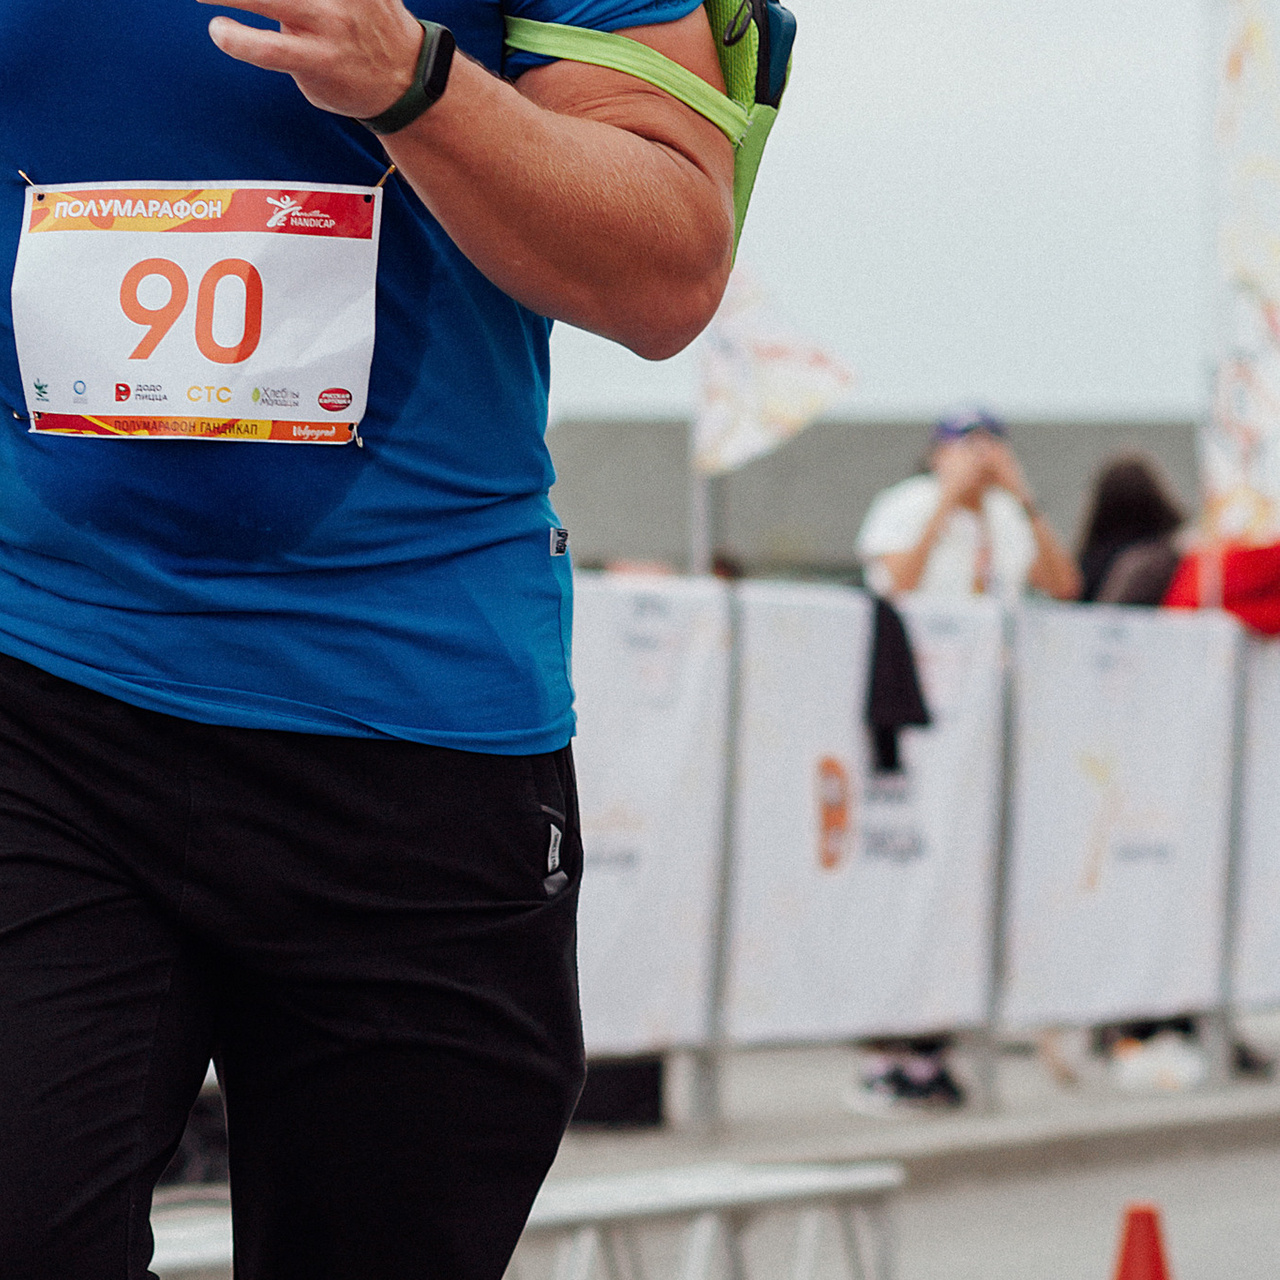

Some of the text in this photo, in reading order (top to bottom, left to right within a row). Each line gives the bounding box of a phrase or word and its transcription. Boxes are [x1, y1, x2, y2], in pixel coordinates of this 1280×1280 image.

[54, 199, 222, 219] ПОЛУМАРАФОН
[290, 216, 336, 229] HANDICAP
[120, 257, 264, 365] 90
[134, 393, 169, 402] ПИЦЦА
[186, 385, 232, 404] СТС
[114, 419, 259, 436] ПОЛУМАРАФОН ГАНДИКАП
